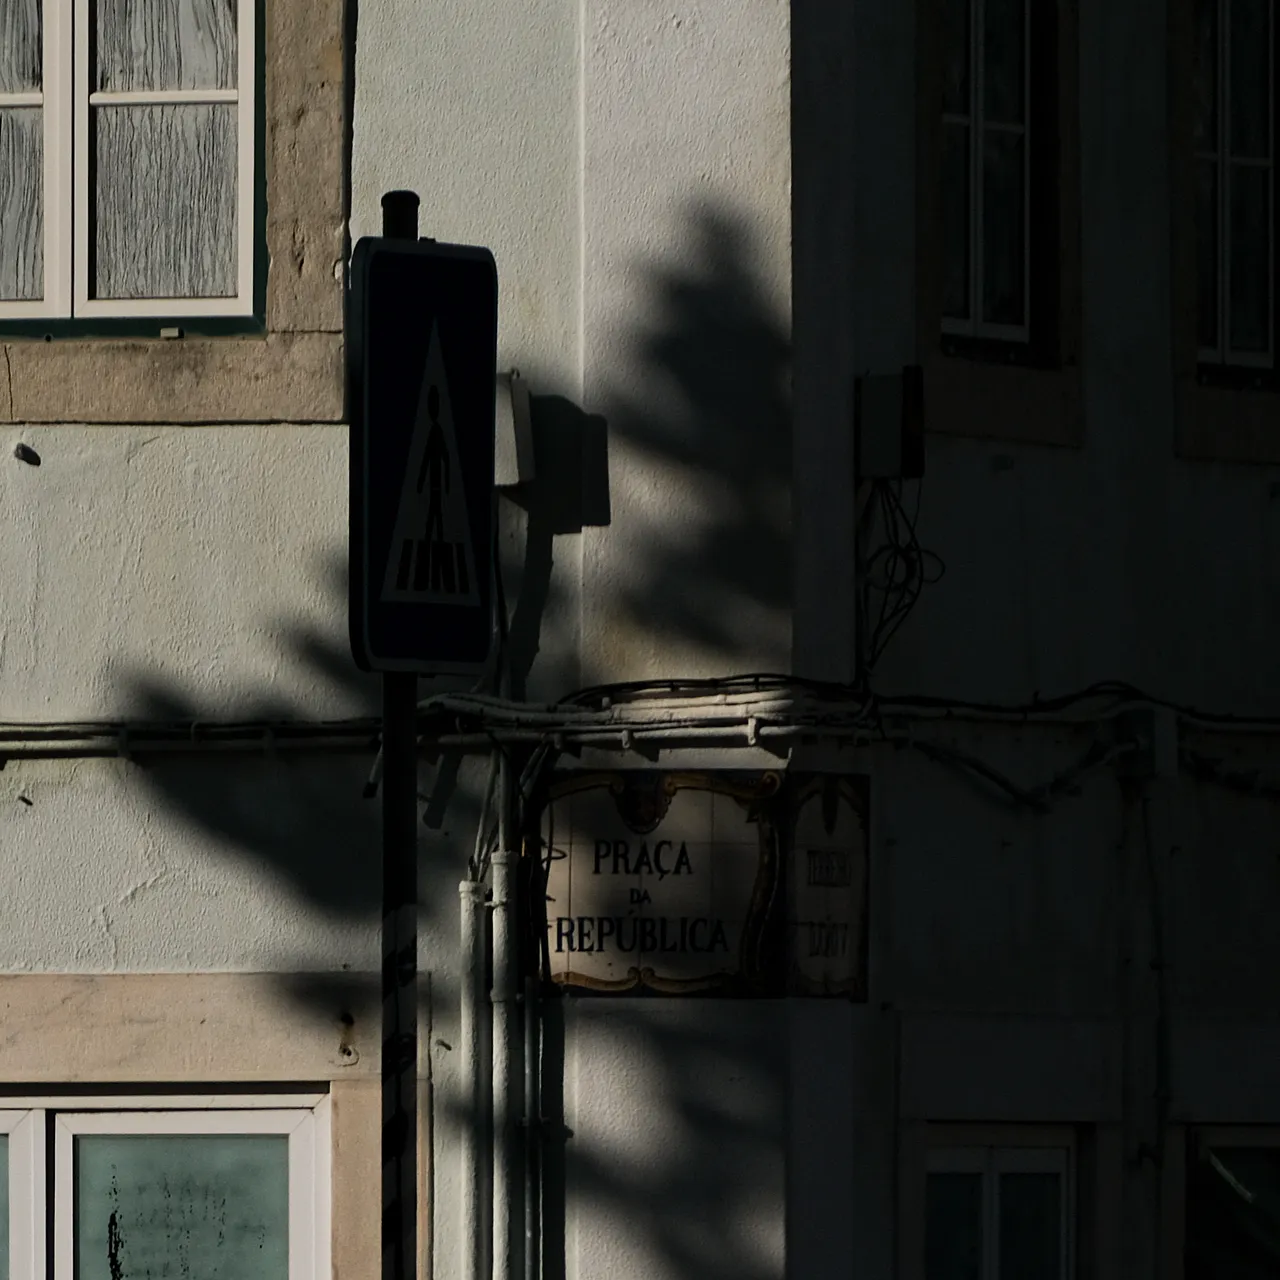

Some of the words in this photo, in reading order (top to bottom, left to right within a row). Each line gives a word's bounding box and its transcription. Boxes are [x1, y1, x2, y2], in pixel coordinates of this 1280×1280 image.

[593, 840, 692, 880] PRAÇA
[629, 888, 652, 905] DA
[555, 910, 729, 953] REPÚBLICA
